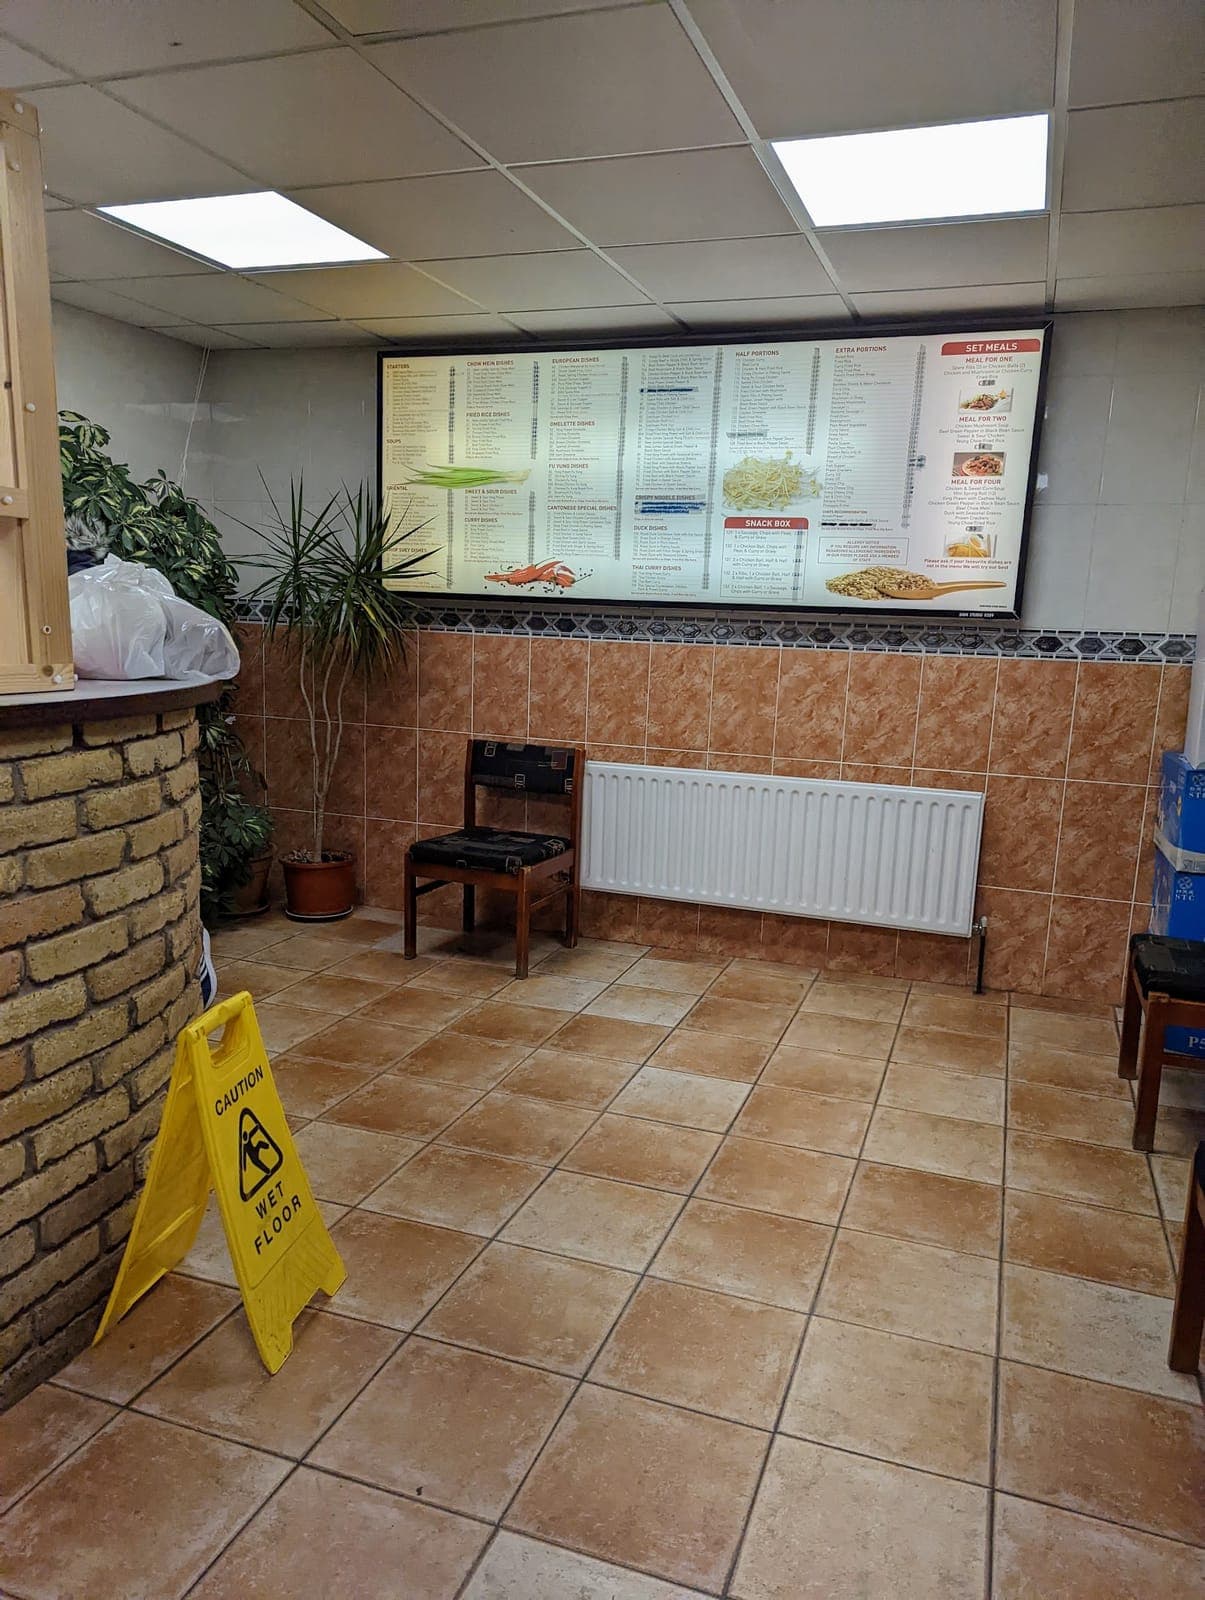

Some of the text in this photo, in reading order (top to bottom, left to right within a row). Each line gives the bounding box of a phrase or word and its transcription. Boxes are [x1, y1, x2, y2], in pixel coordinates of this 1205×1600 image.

[965, 342, 1018, 353] SET MEALS
[745, 519, 791, 527] SNACK BOX
[215, 1065, 264, 1116] CAUTION
[255, 1181, 284, 1219] WET
[254, 1195, 302, 1255] FLOOR
